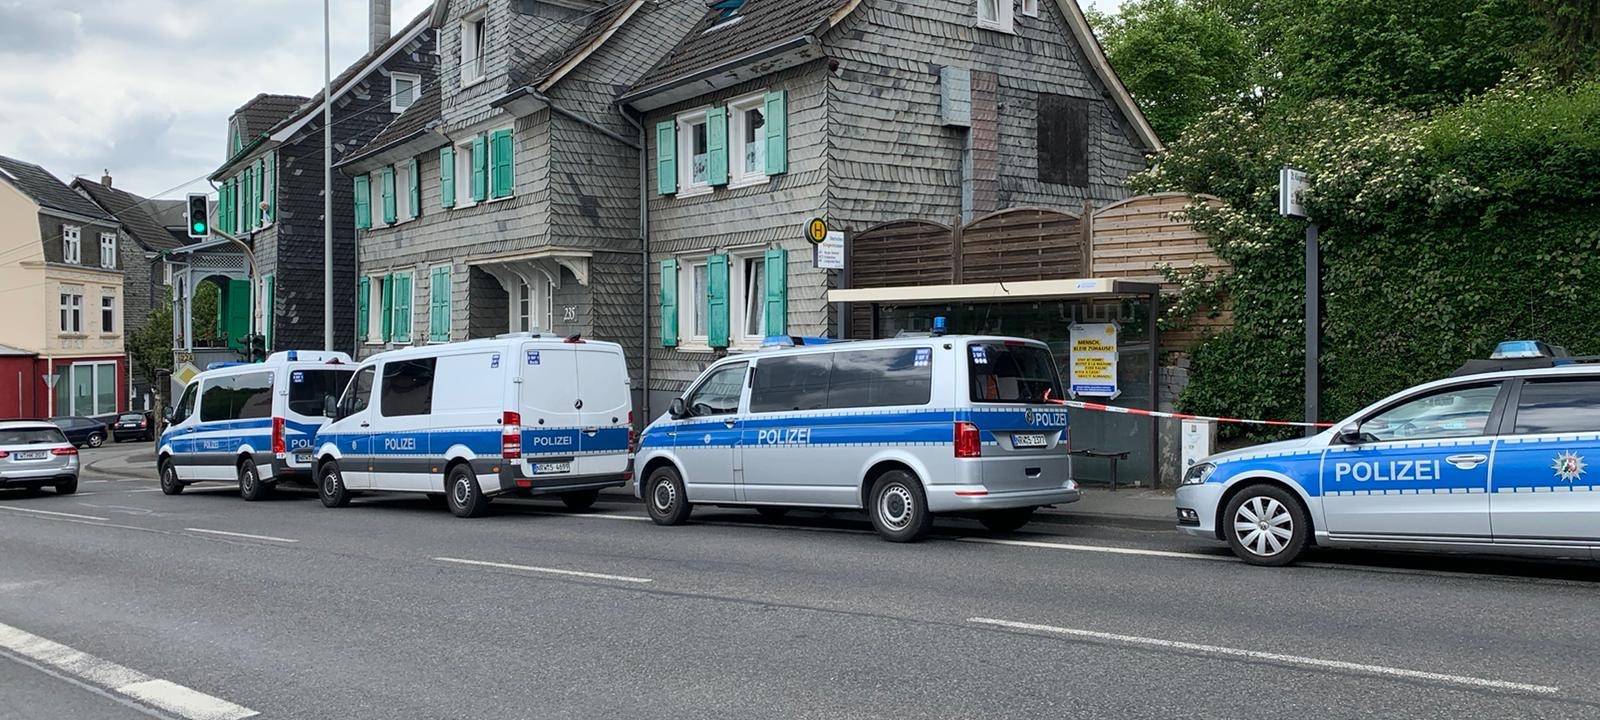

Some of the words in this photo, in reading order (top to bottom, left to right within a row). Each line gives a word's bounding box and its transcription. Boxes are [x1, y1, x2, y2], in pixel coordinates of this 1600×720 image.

[814, 223, 823, 238] H
[564, 307, 575, 320] 235
[1035, 413, 1067, 426] POLIZEI
[534, 436, 572, 446] POLIZEI
[758, 428, 811, 445] POLIZEI
[385, 438, 416, 450] POLIZEI
[1335, 460, 1441, 482] POLIZEI
